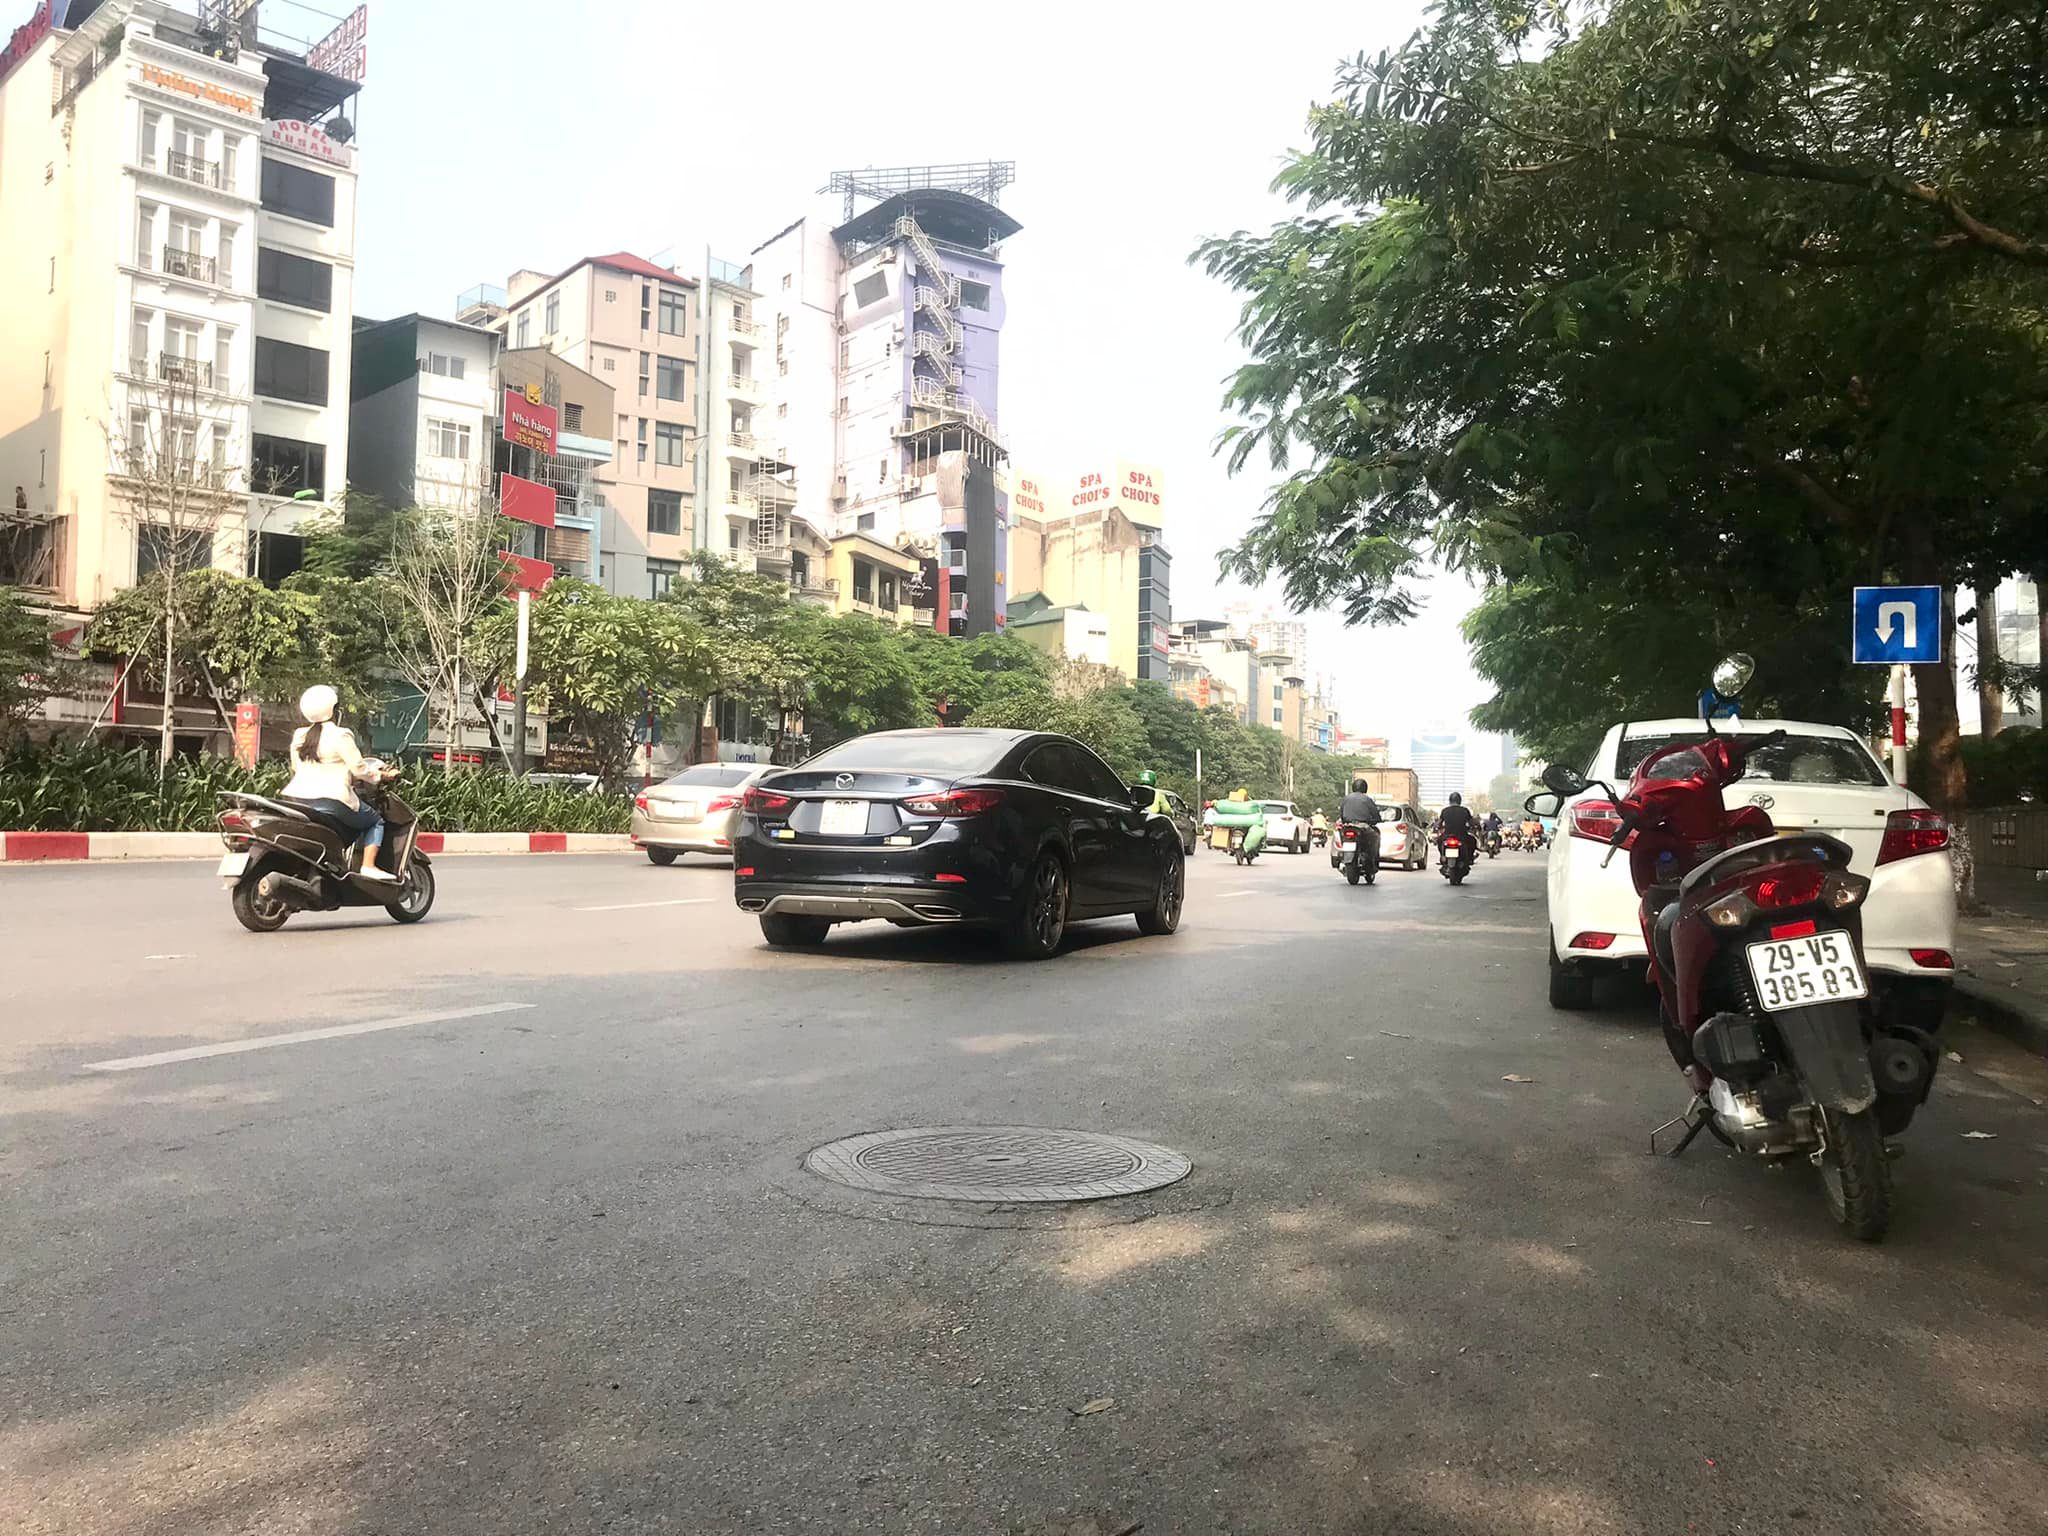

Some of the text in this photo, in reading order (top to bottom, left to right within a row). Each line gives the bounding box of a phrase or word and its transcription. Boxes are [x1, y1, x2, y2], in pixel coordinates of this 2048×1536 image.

[278, 120, 327, 144] HOTEL
[272, 130, 332, 155] BUSAN
[1021, 479, 1039, 496] SPA
[1080, 473, 1102, 488] SPA
[1129, 471, 1153, 487] SPA
[1015, 494, 1044, 513] CHOI'S
[1072, 487, 1110, 506] CHOI'S
[1121, 486, 1160, 505] CHOI'S
[1764, 936, 1839, 973] 29-V5
